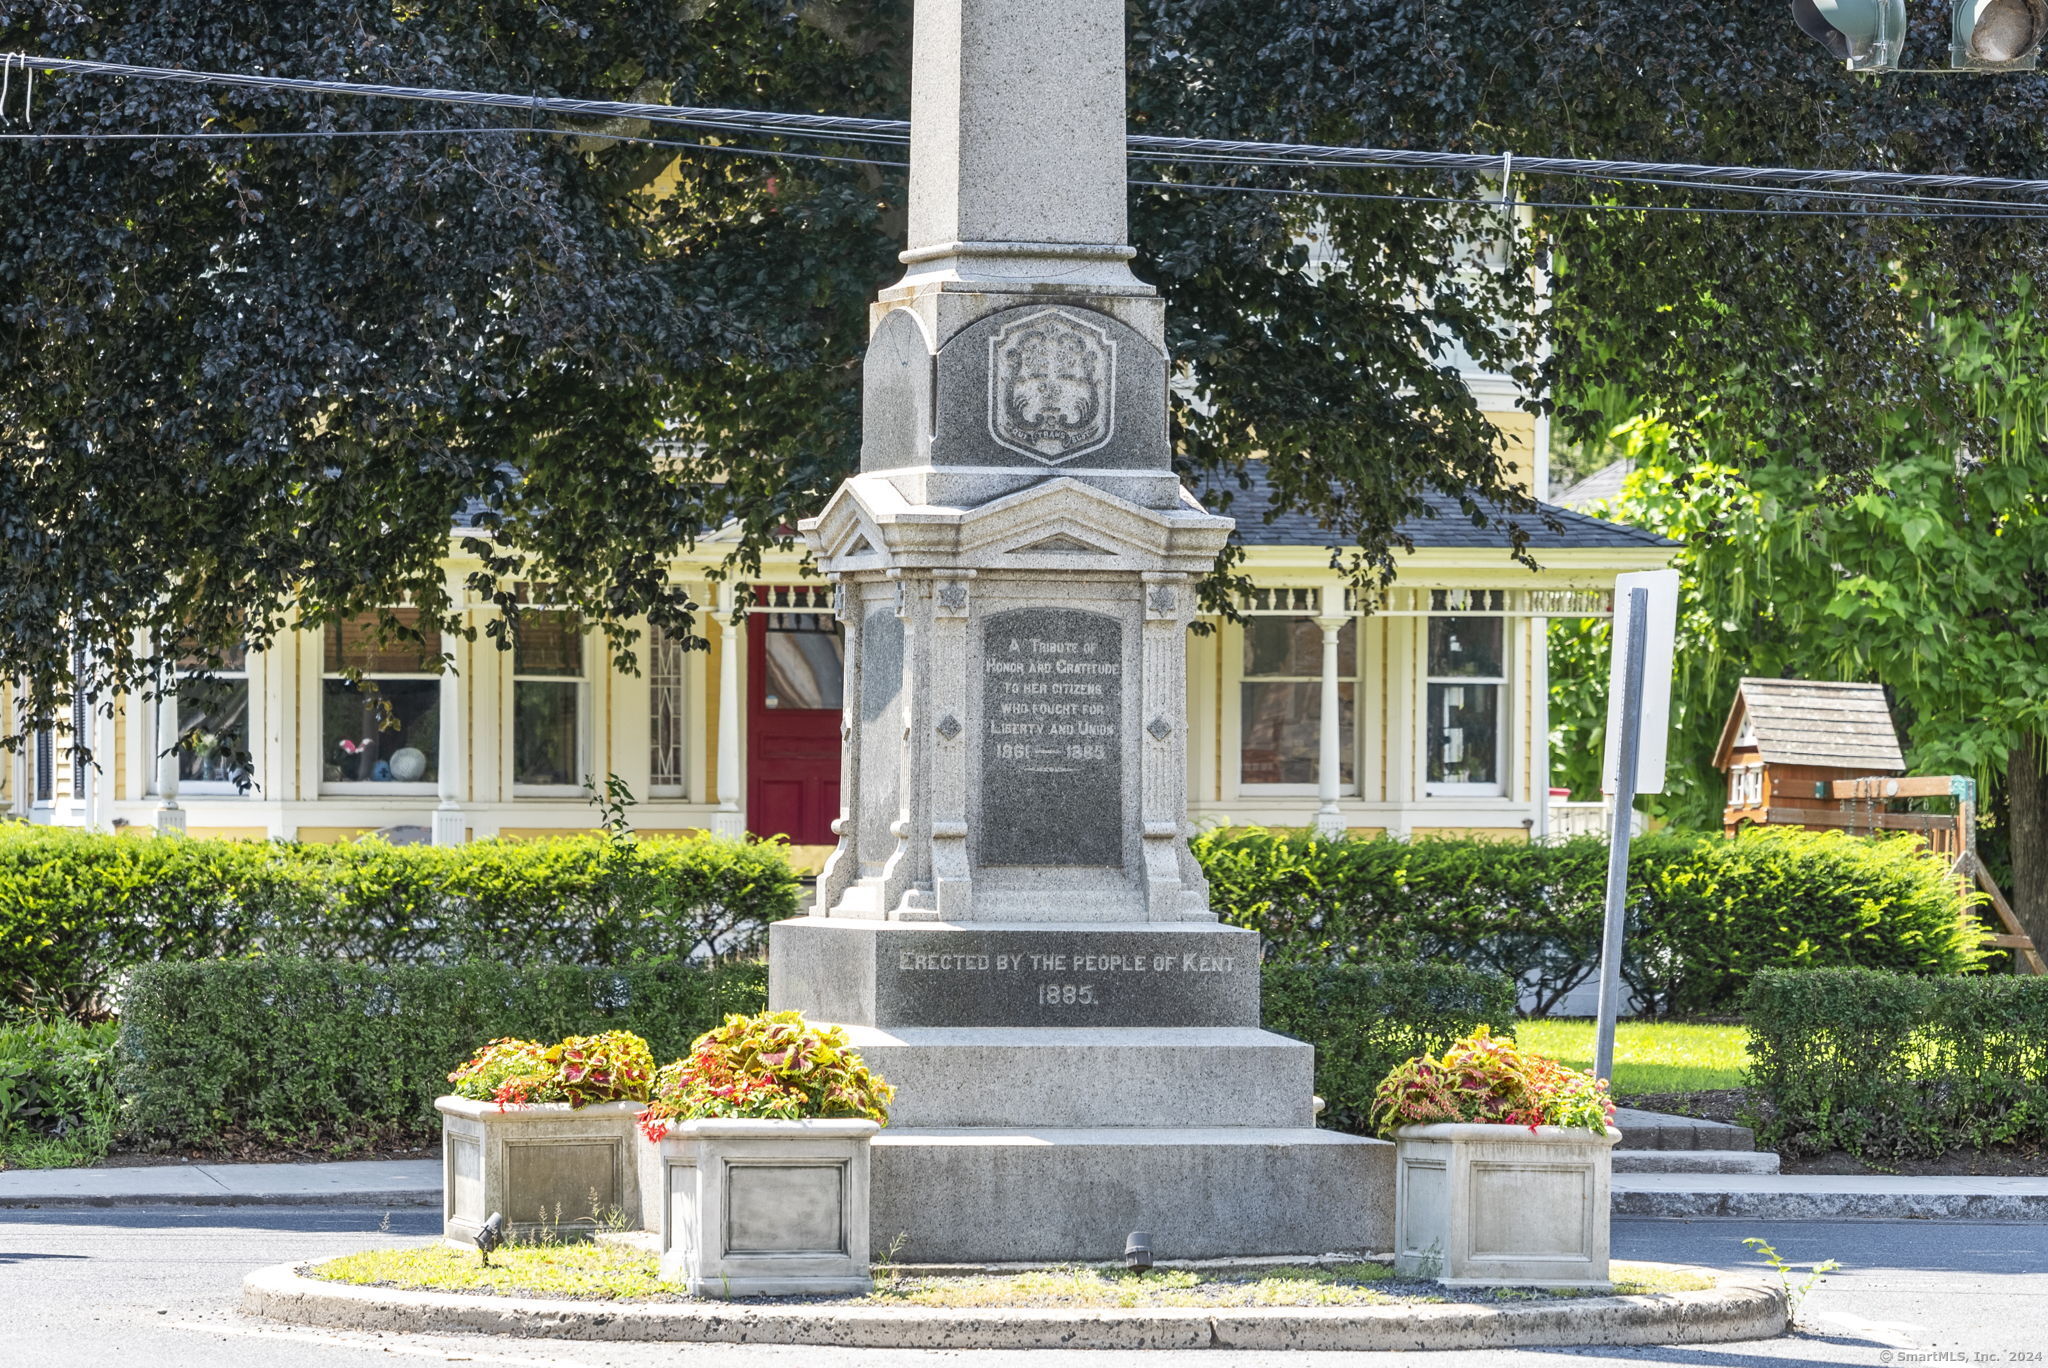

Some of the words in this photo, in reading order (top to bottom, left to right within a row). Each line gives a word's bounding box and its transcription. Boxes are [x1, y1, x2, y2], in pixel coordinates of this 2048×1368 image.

[1008, 638, 1020, 652] A
[1032, 638, 1078, 654] TRIBUTE
[1083, 642, 1098, 655] OF
[1028, 662, 1051, 674] AND
[1056, 659, 1120, 675] GRATITUDE
[1004, 682, 1019, 694] TO
[1023, 682, 1047, 694] HER
[1052, 682, 1102, 695] CITIZENS
[1001, 703, 1029, 715] WHO
[1032, 703, 1079, 715] FOUGHT
[1082, 704, 1104, 715] FOR
[990, 720, 1044, 735] LIBERTY
[1049, 723, 1074, 735] AND
[1078, 721, 1114, 735] UNION
[900, 952, 989, 971] ERECTED
[997, 954, 1021, 971] BY
[1029, 954, 1067, 971] THE
[1073, 954, 1146, 972] PEOPLE
[1153, 955, 1178, 972] OF
[1182, 953, 1235, 972] KENT
